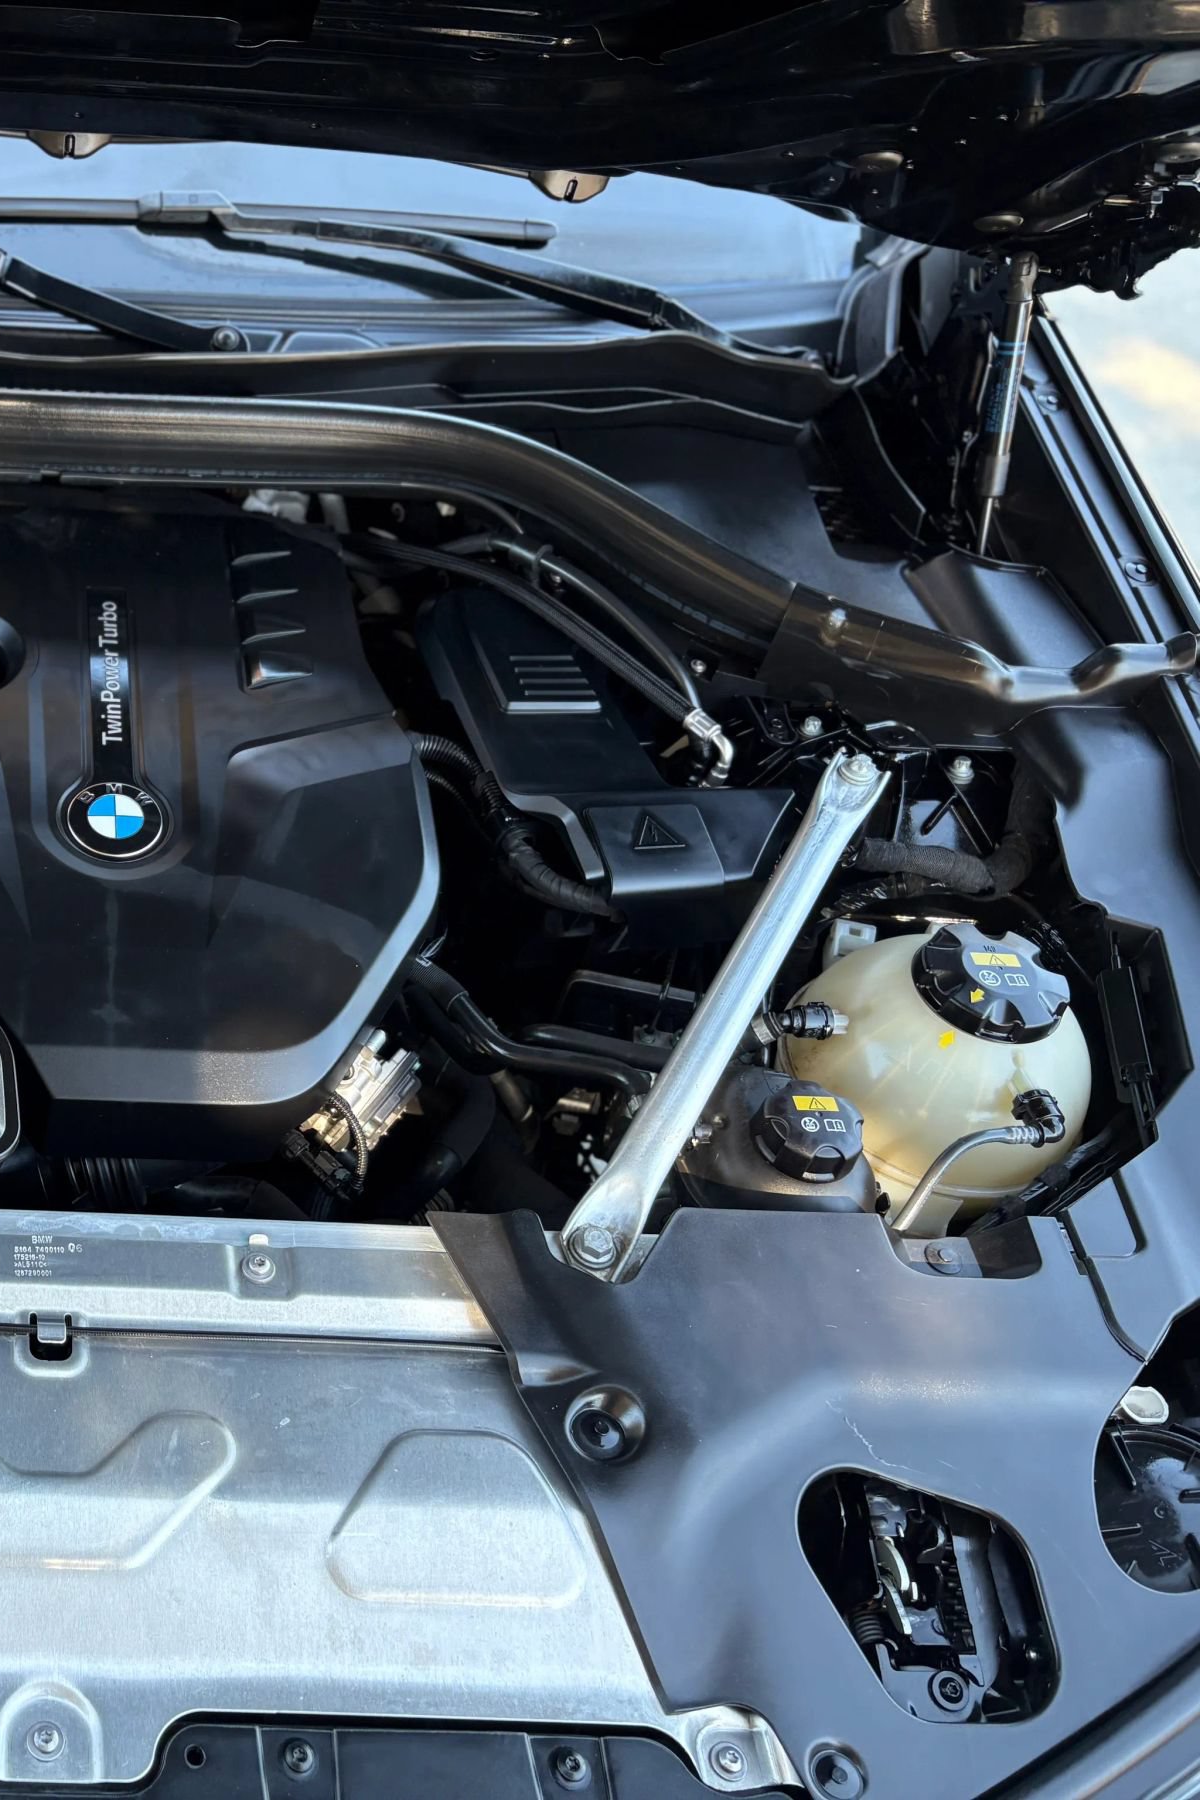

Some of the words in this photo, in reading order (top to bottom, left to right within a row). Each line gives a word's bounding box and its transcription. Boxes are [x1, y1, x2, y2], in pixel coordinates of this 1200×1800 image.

[98, 600, 119, 648] Turbo
[101, 650, 124, 746] TwinPower
[78, 783, 154, 807] BMW
[31, 1235, 53, 1244] BMW
